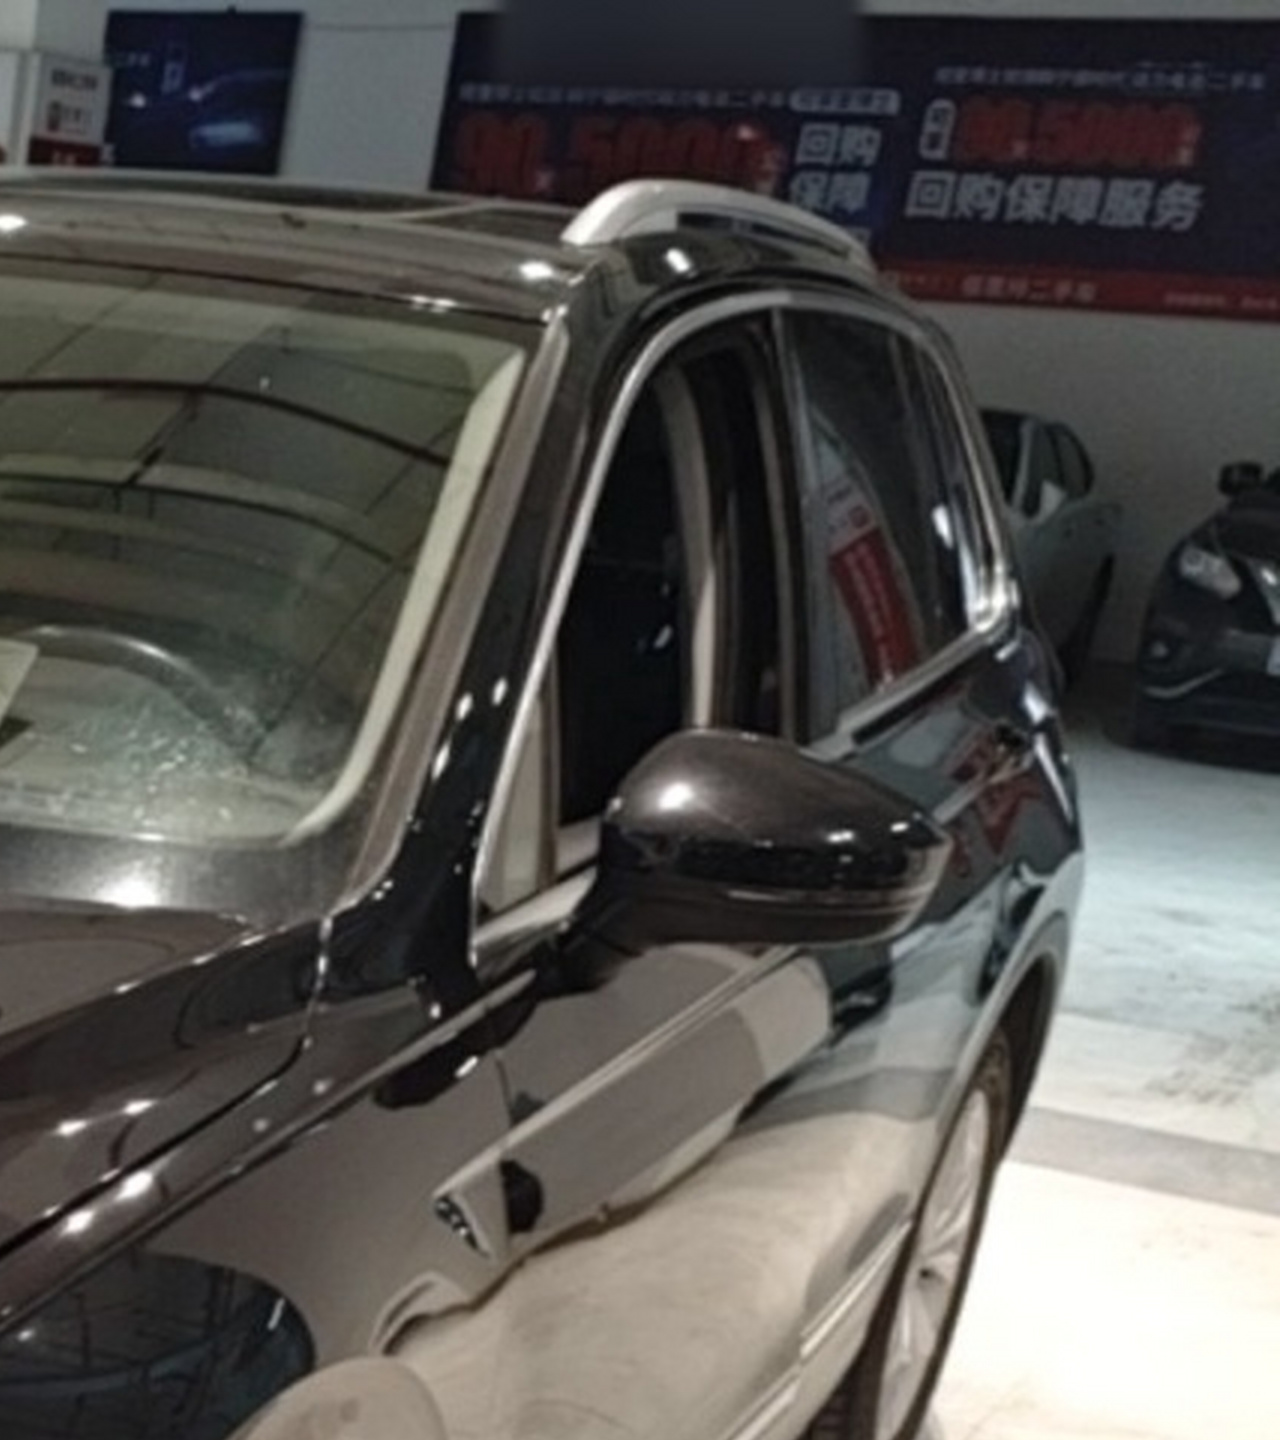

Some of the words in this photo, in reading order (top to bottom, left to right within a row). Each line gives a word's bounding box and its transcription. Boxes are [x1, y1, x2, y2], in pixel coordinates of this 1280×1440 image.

[795, 121, 882, 167] 回购
[904, 170, 1206, 232] 回购保障服务
